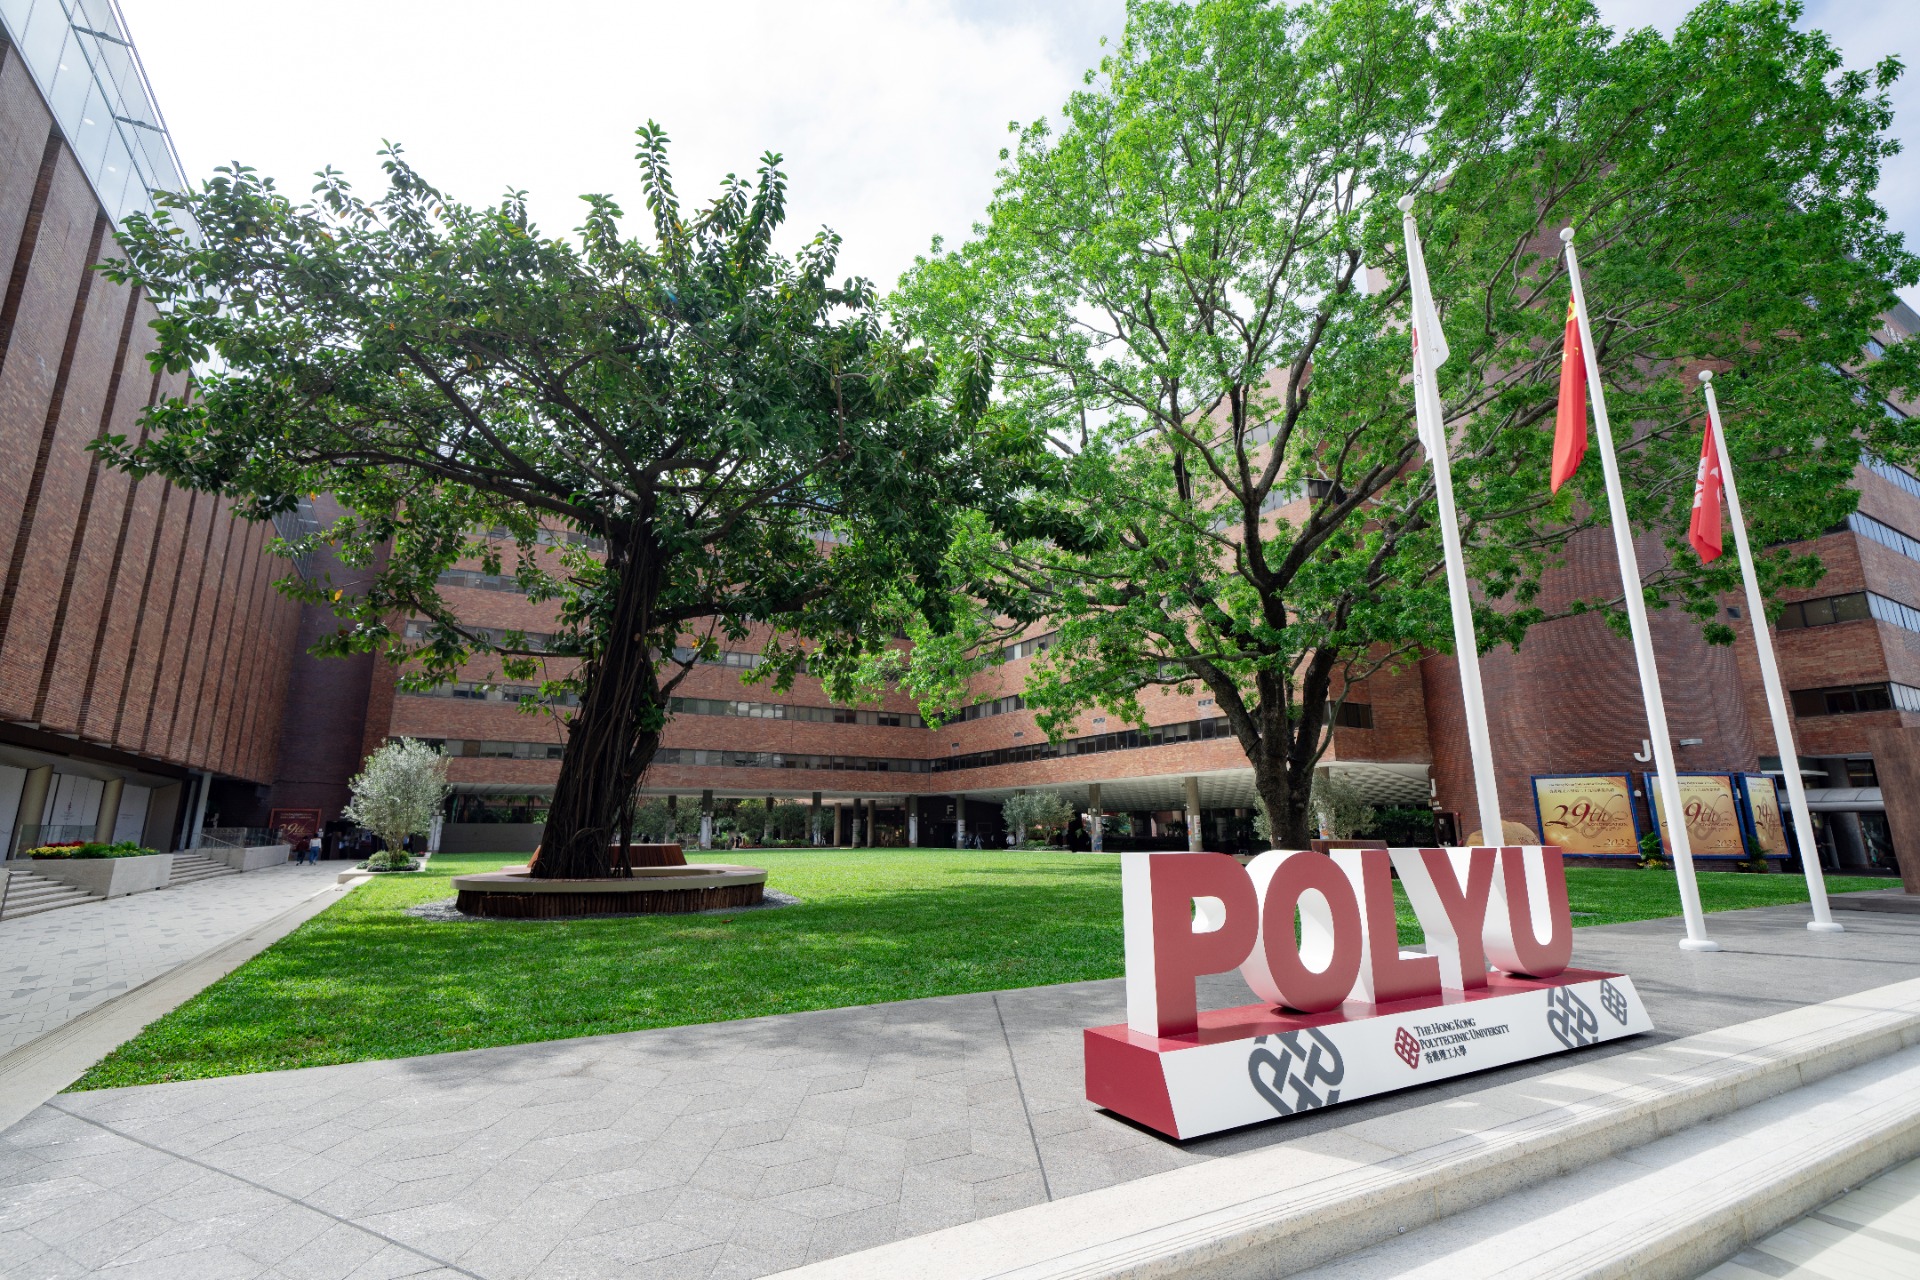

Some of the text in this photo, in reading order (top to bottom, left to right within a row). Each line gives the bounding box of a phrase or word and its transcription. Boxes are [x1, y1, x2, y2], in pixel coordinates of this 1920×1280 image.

[1633, 739, 1651, 762] J
[946, 804, 954, 815] F
[1545, 794, 1624, 830] 29th
[1603, 838, 1631, 846] 2023
[1716, 839, 1737, 847] 2023
[1140, 846, 1572, 1037] POLYU
[1413, 1018, 1476, 1037] THE HONG KONG
[1419, 1024, 1510, 1050] POLYTECHNIC UNIVERSITY
